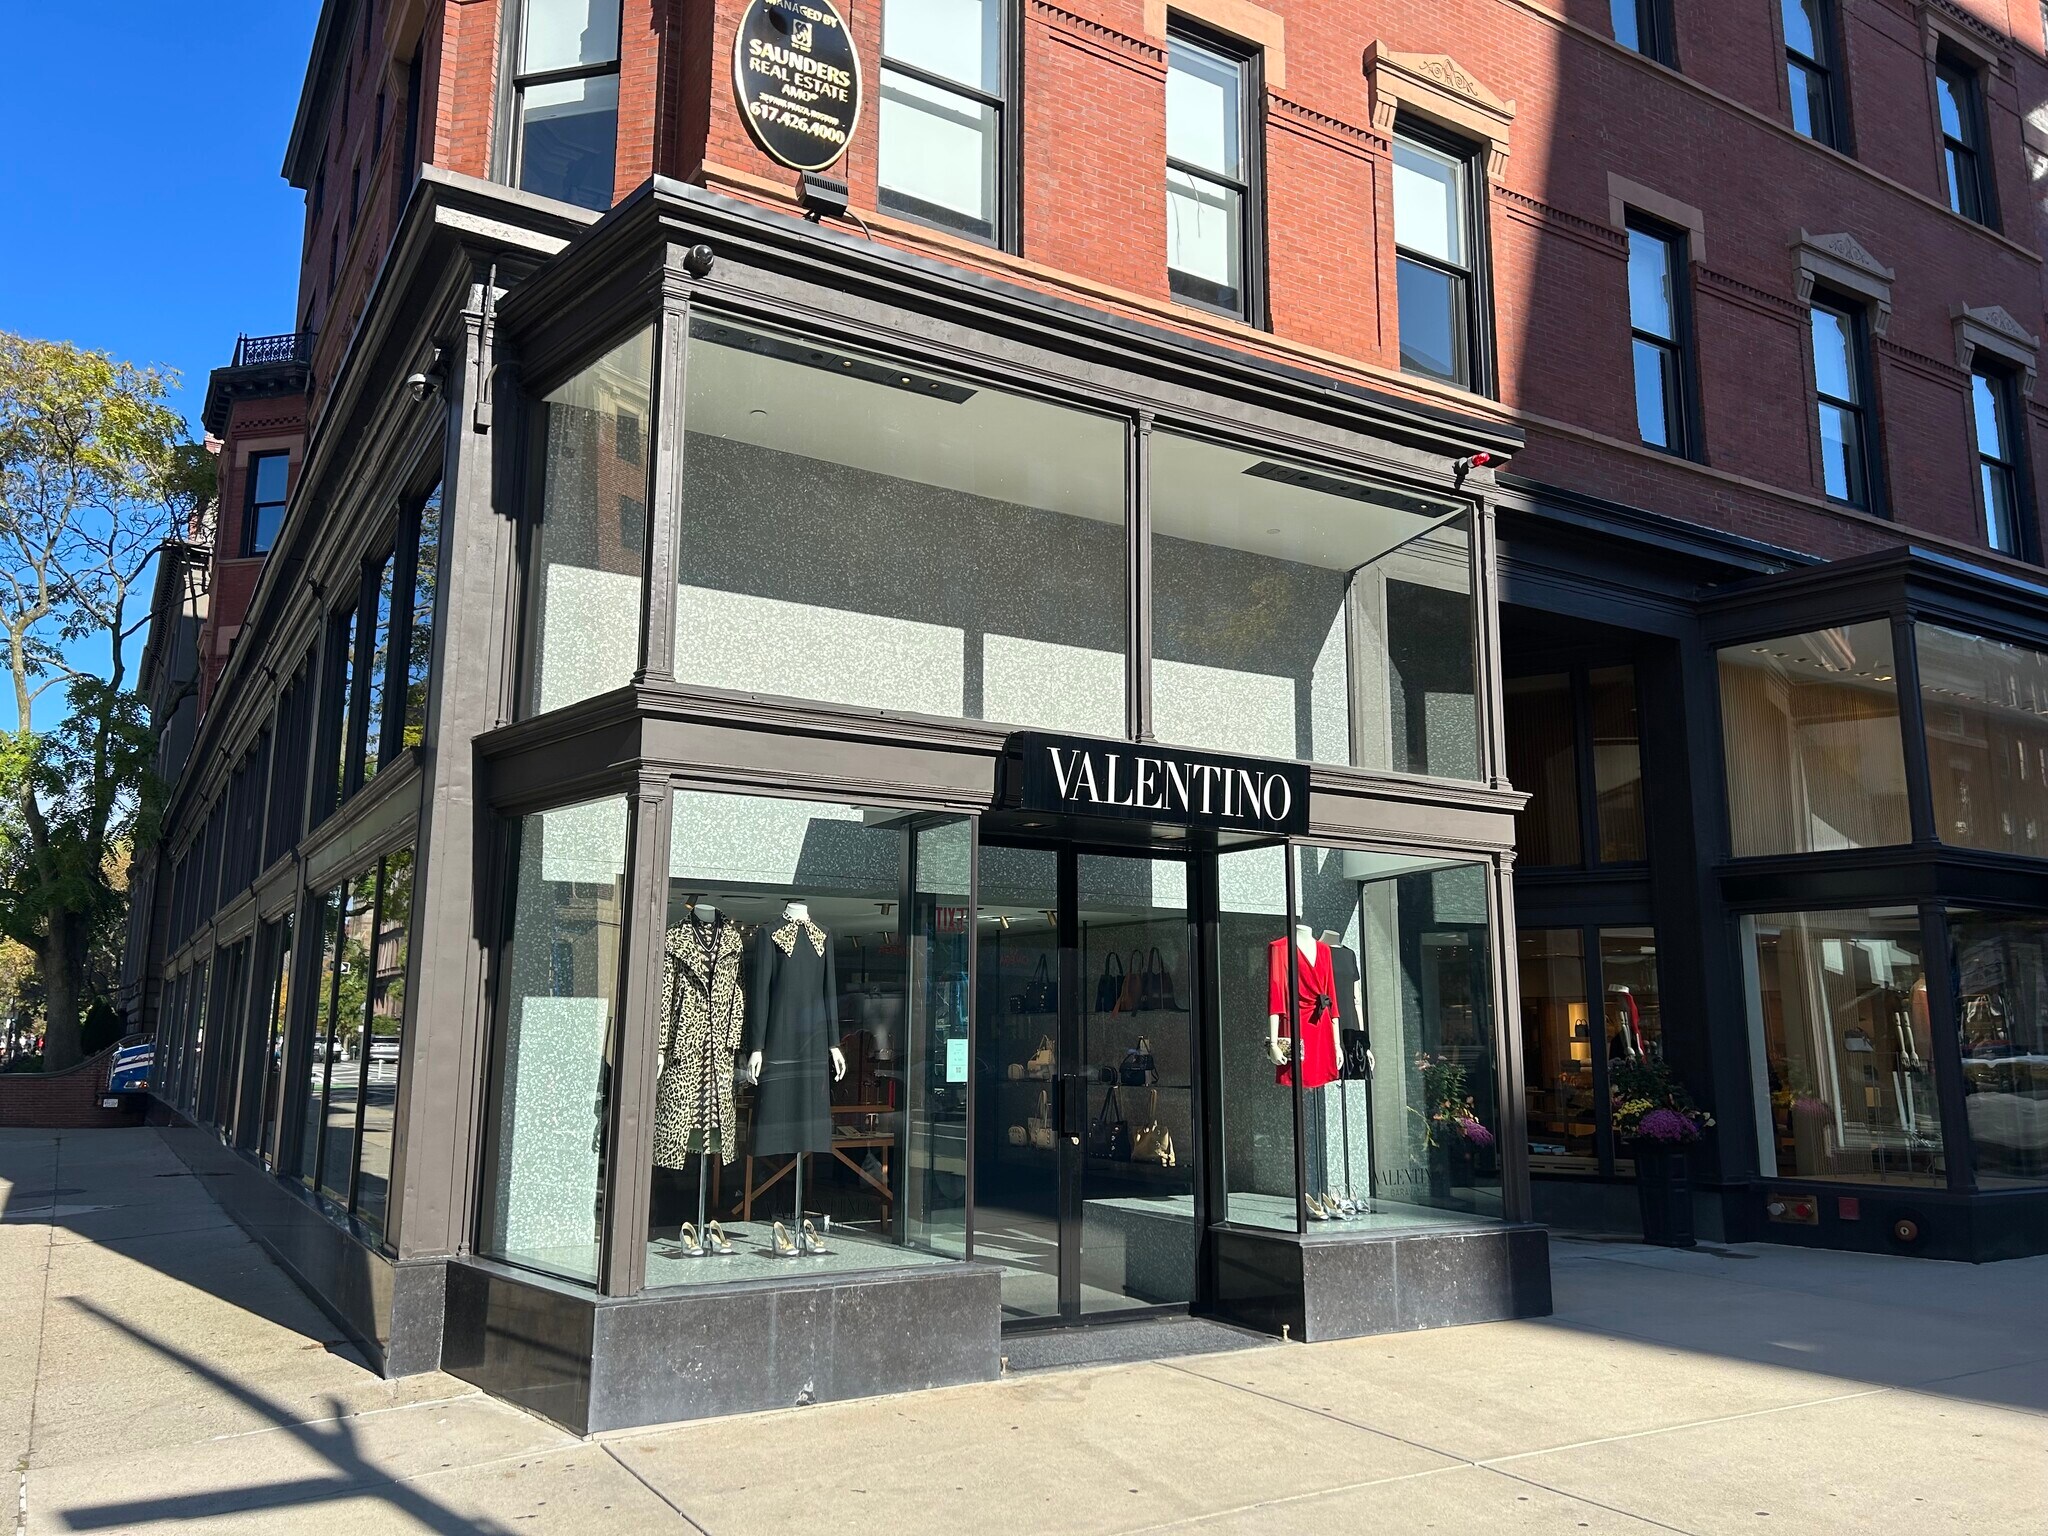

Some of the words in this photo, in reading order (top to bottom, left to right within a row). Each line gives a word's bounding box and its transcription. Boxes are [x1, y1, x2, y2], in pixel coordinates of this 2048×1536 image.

[823, 14, 838, 28] BY
[749, 38, 850, 87] SAUNDERS
[749, 57, 790, 82] REAL
[794, 73, 848, 103] ESTATE
[750, 101, 846, 145] 617.426.4000
[1046, 746, 1292, 821] VALENTINO
[1373, 1168, 1436, 1185] VALENTIN
